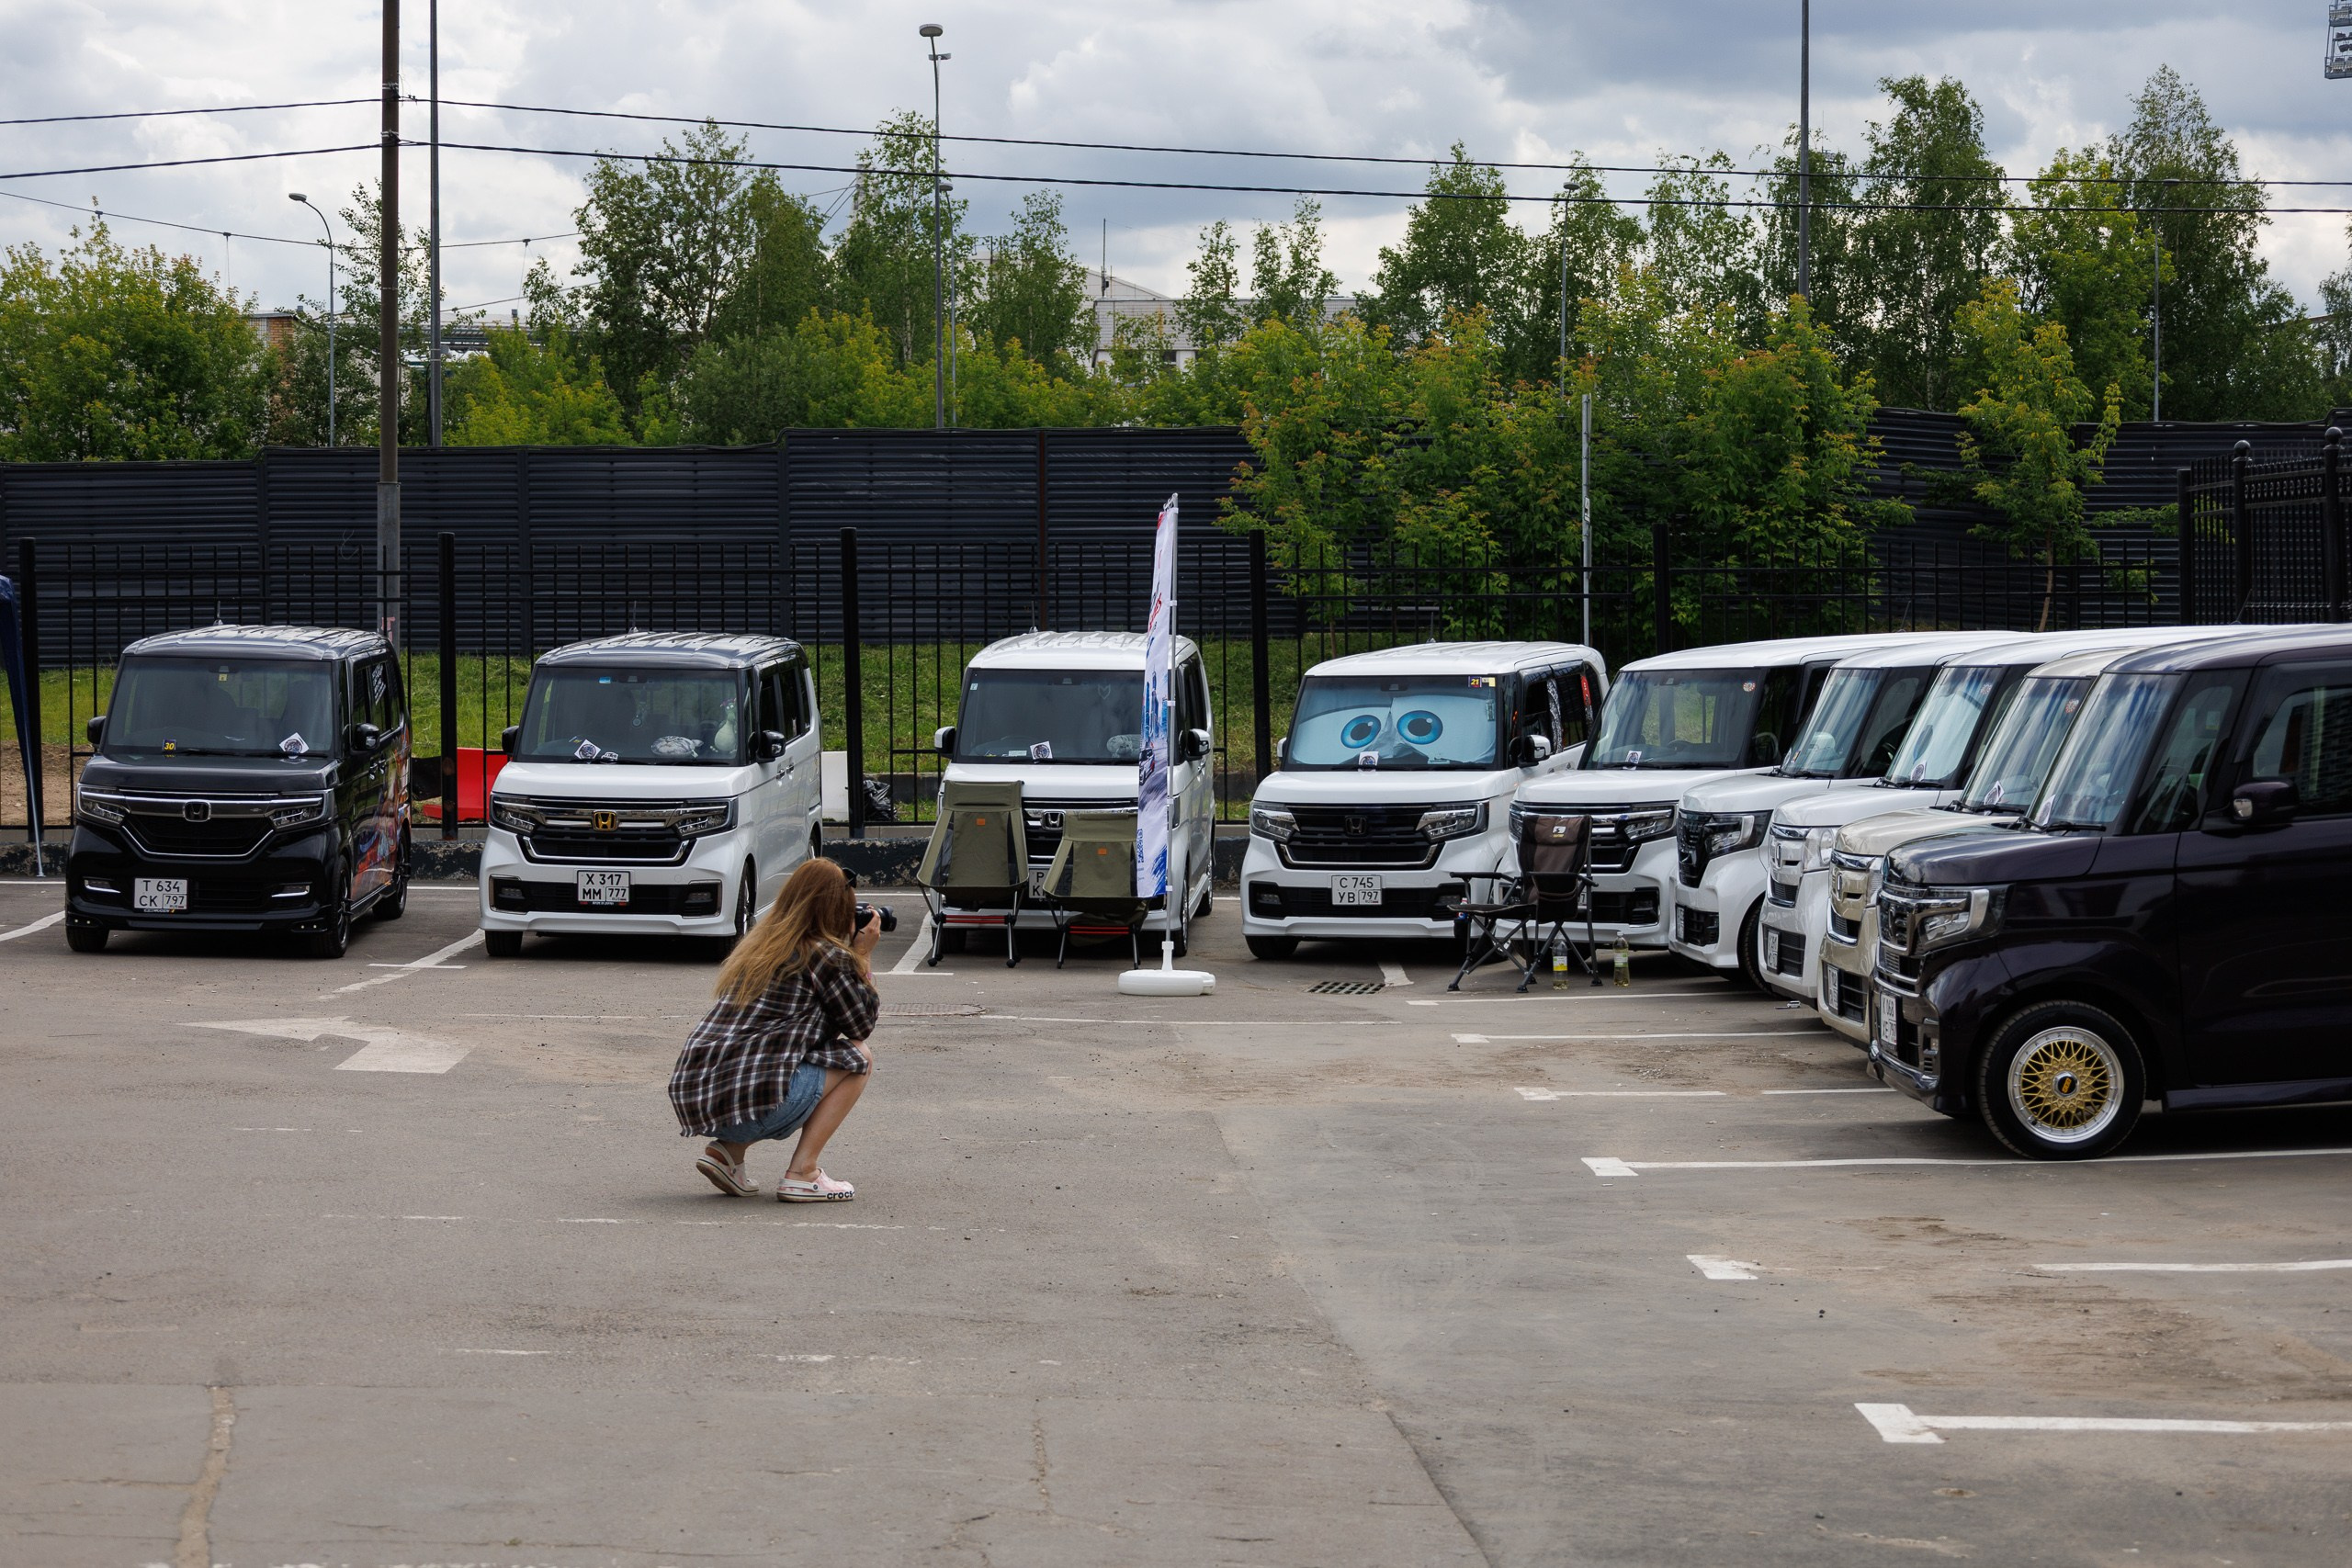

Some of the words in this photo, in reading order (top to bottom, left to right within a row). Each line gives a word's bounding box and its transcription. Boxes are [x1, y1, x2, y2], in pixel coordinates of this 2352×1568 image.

[164, 742, 175, 750] 30
[599, 874, 621, 886] 317
[1351, 877, 1374, 888] 745
[156, 881, 179, 892] 634
[608, 888, 627, 897] 777
[1362, 892, 1378, 900] 797
[165, 895, 184, 905] 797
